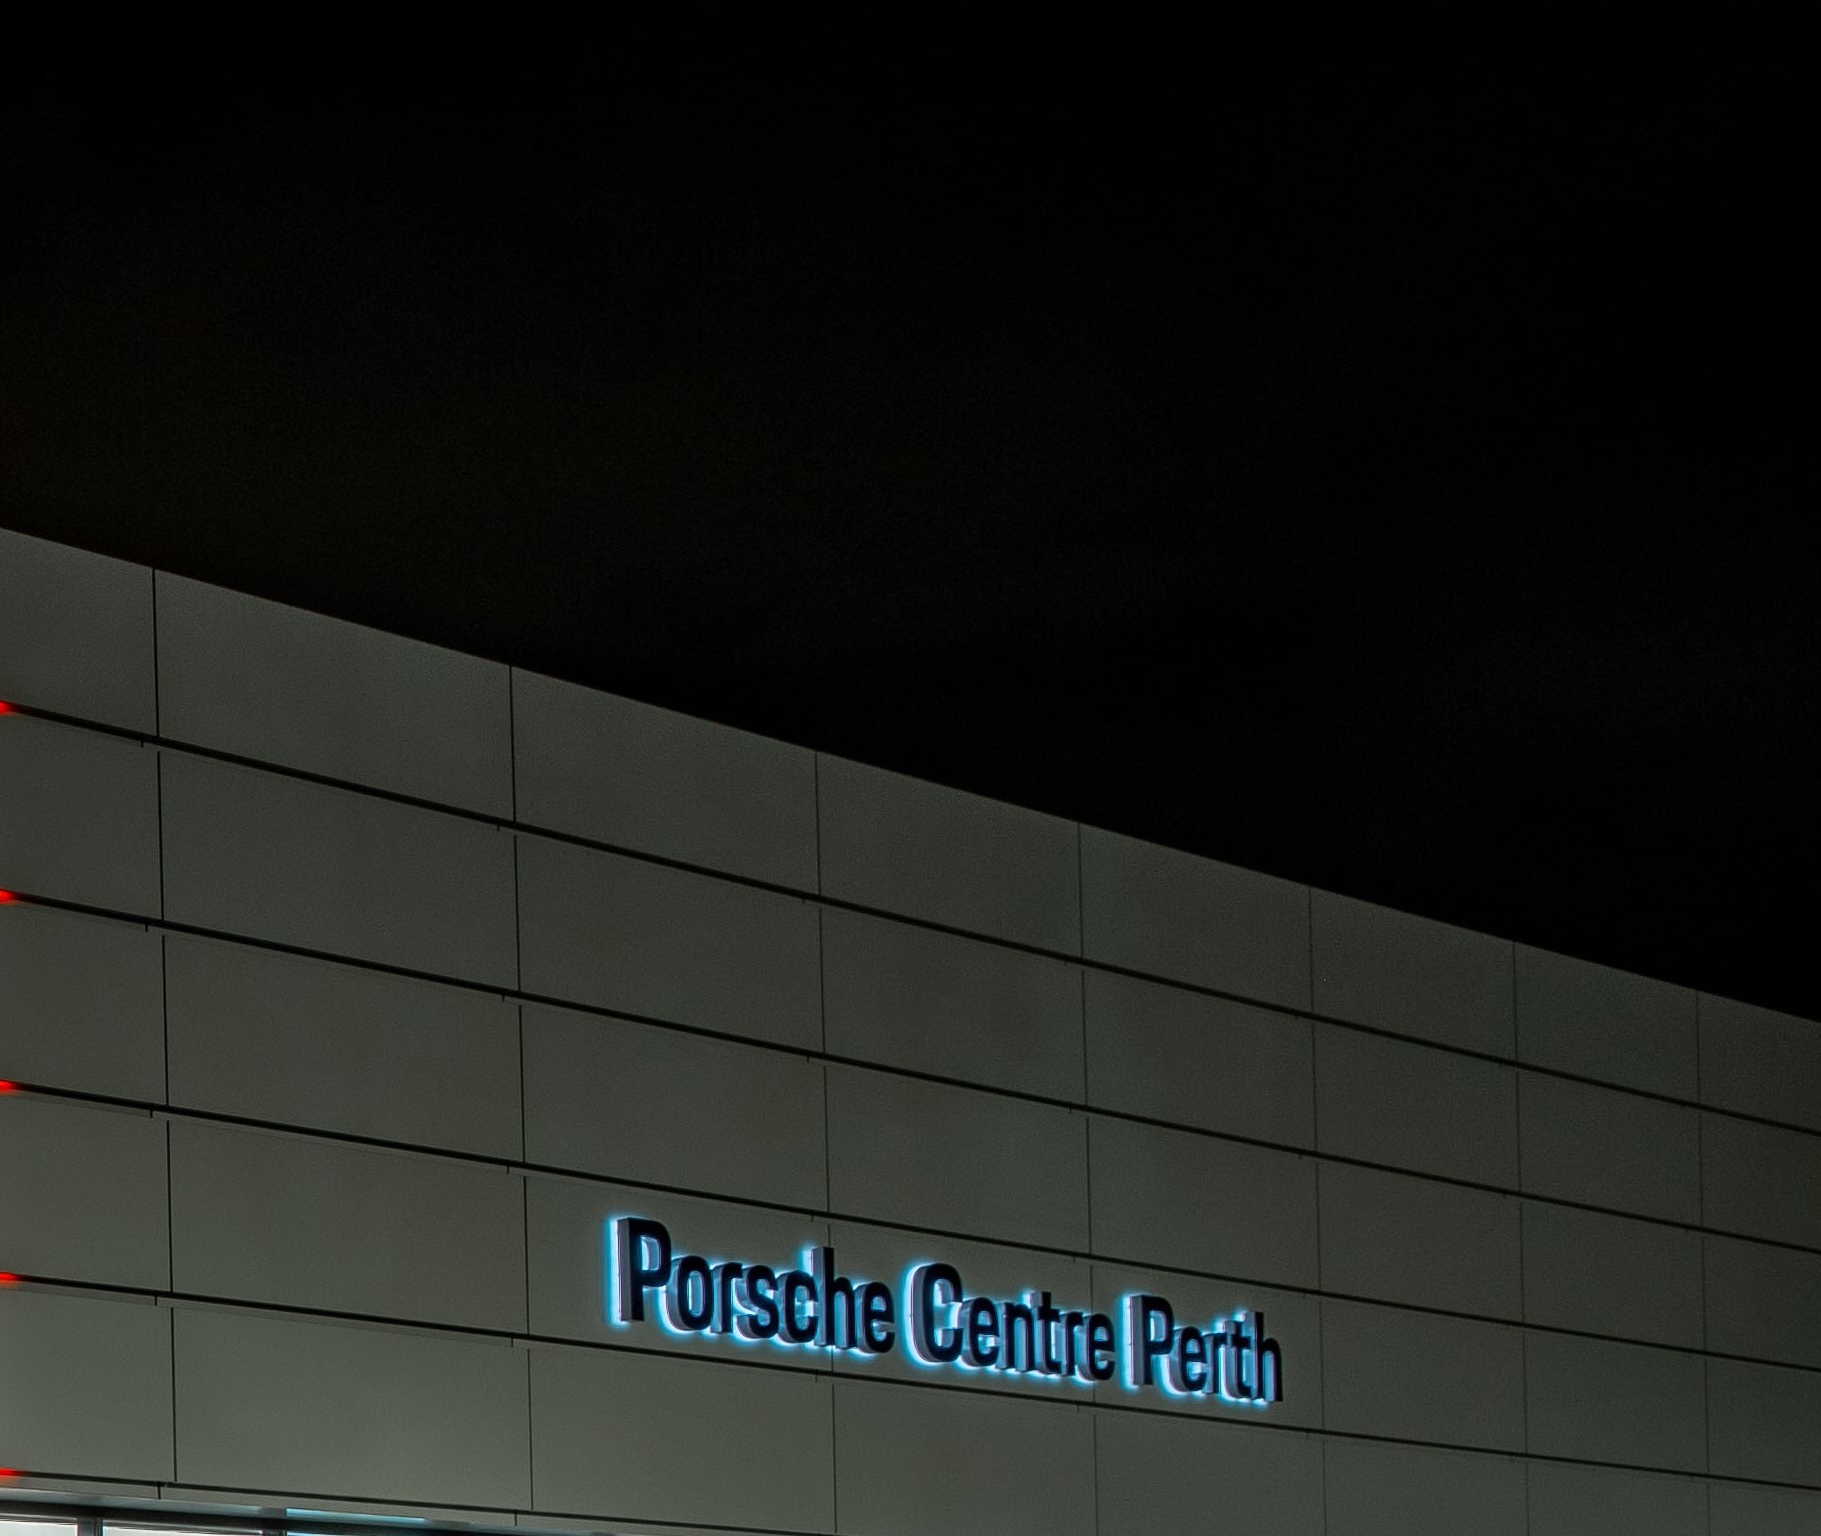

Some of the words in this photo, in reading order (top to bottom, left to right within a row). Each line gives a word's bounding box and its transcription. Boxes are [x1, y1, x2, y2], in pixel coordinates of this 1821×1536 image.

[616, 1216, 896, 1355] Porsche
[911, 1262, 1116, 1383] Centre
[1130, 1294, 1284, 1403] Perth
